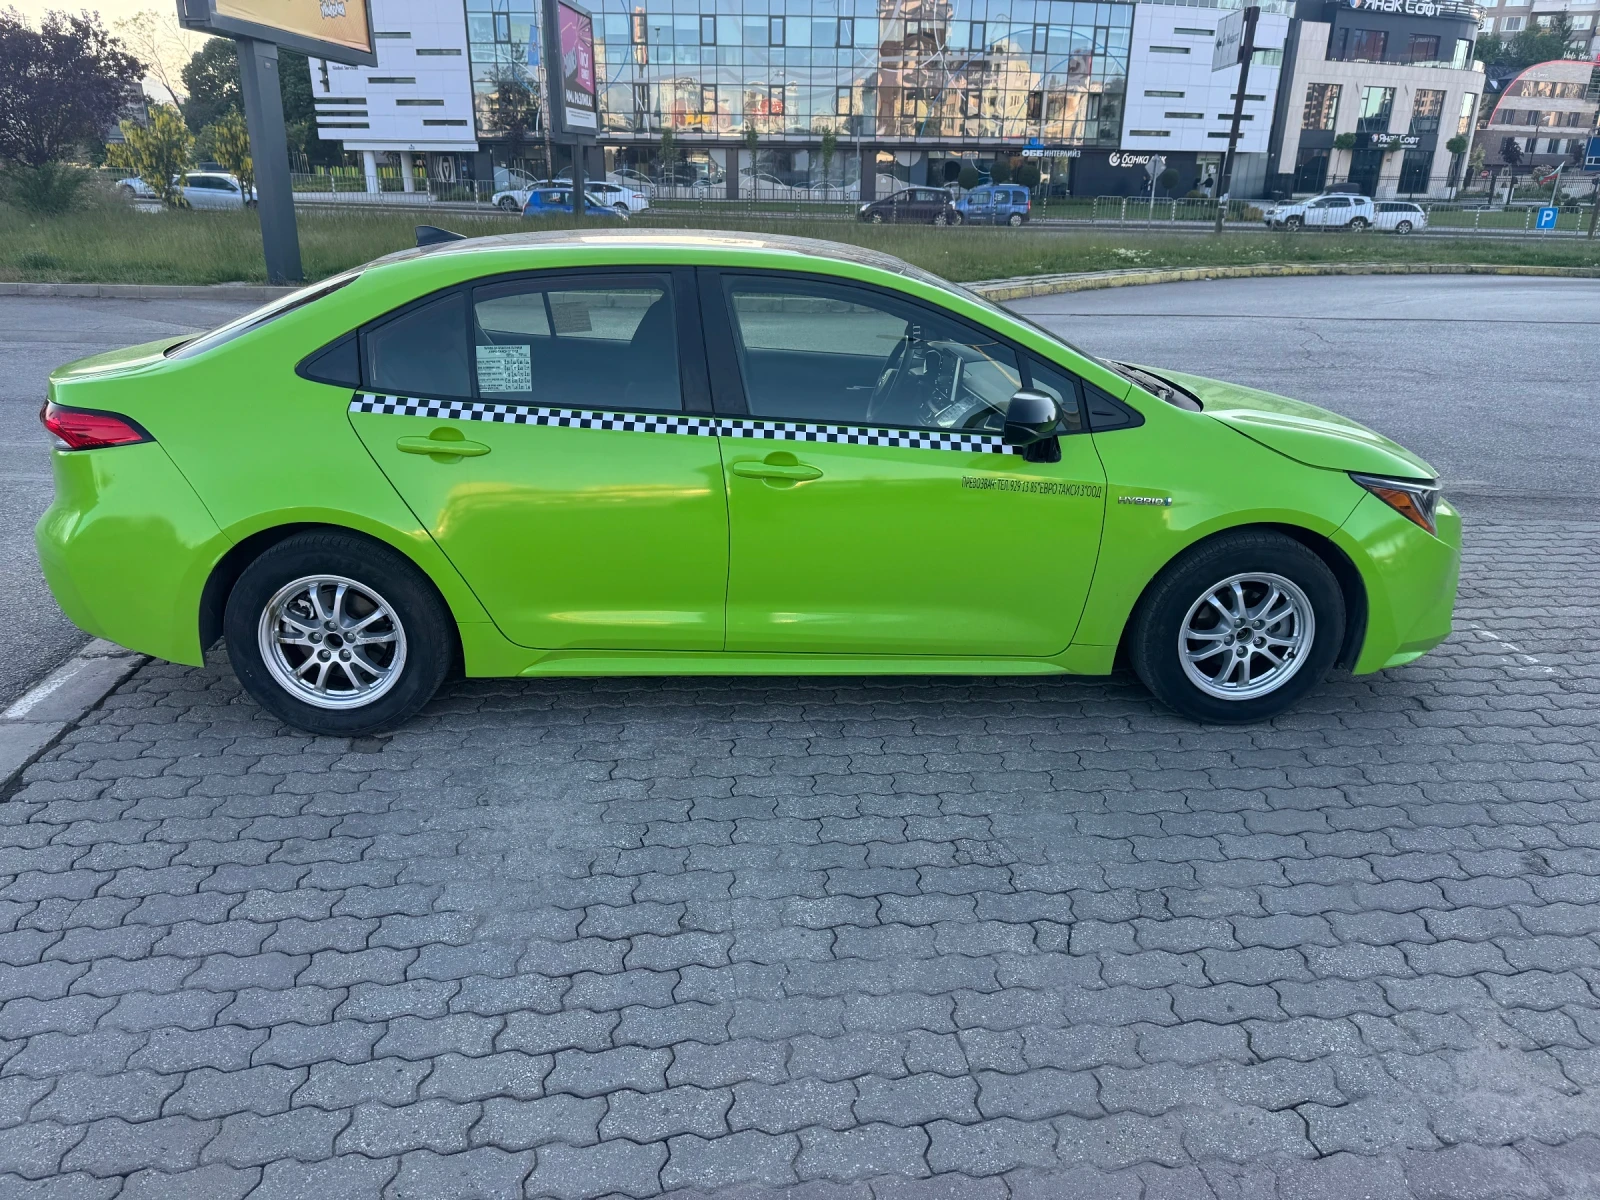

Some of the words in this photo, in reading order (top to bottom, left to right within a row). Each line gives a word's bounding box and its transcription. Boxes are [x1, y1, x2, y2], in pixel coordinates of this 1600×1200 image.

[1405, 0, 1444, 17] Софт
[1399, 134, 1420, 144] Софт
[1022, 149, 1044, 157] ОББ
[1044, 148, 1081, 158] ИНТЕРЛИЙЗ
[1121, 152, 1150, 165] банка
[1541, 210, 1554, 227] P
[1117, 496, 1164, 506] HYBRID
